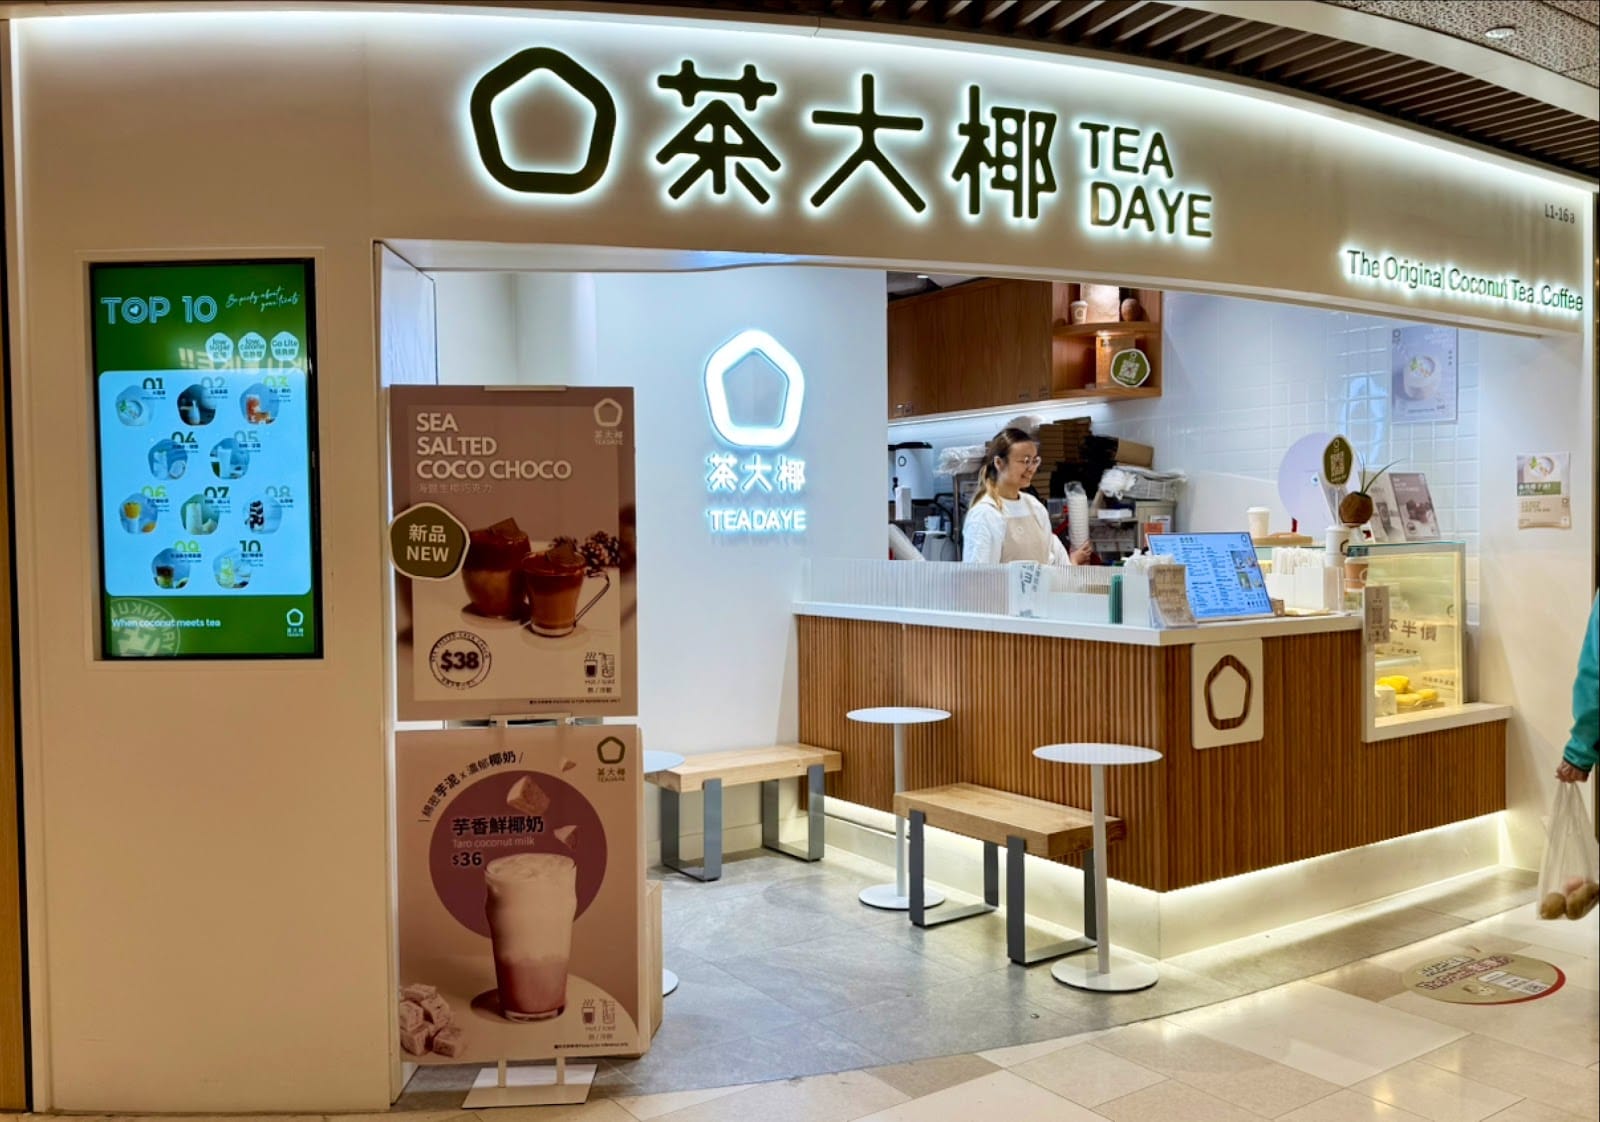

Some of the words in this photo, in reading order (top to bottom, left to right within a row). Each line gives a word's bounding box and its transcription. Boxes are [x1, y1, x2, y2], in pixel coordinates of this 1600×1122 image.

[656, 60, 1057, 219] 茶大椰
[1079, 122, 1174, 178] TEA
[1091, 181, 1213, 238] DAYE
[1347, 250, 1380, 278] The
[1384, 256, 1446, 289] Original
[1449, 268, 1508, 299] Coconut
[101, 295, 171, 325] TOP
[181, 295, 219, 323] 10
[416, 412, 459, 432] SEA
[416, 436, 498, 456] SALTED
[416, 460, 486, 479] COCO
[489, 460, 572, 479] CHOCO
[705, 452, 806, 493] 茶大椰
[706, 508, 807, 532] TEADAYE
[408, 523, 447, 543] 新品
[407, 545, 449, 562] NEW
[111, 619, 138, 628] When
[139, 619, 176, 628] coconut
[177, 619, 203, 628] meets
[205, 619, 221, 627] tea
[440, 649, 480, 672] $38
[452, 815, 544, 836] 芋香鮮椰奶
[454, 839, 473, 848] Taro
[474, 838, 513, 848] coconut
[515, 836, 535, 846] milk
[452, 852, 483, 866] $36
